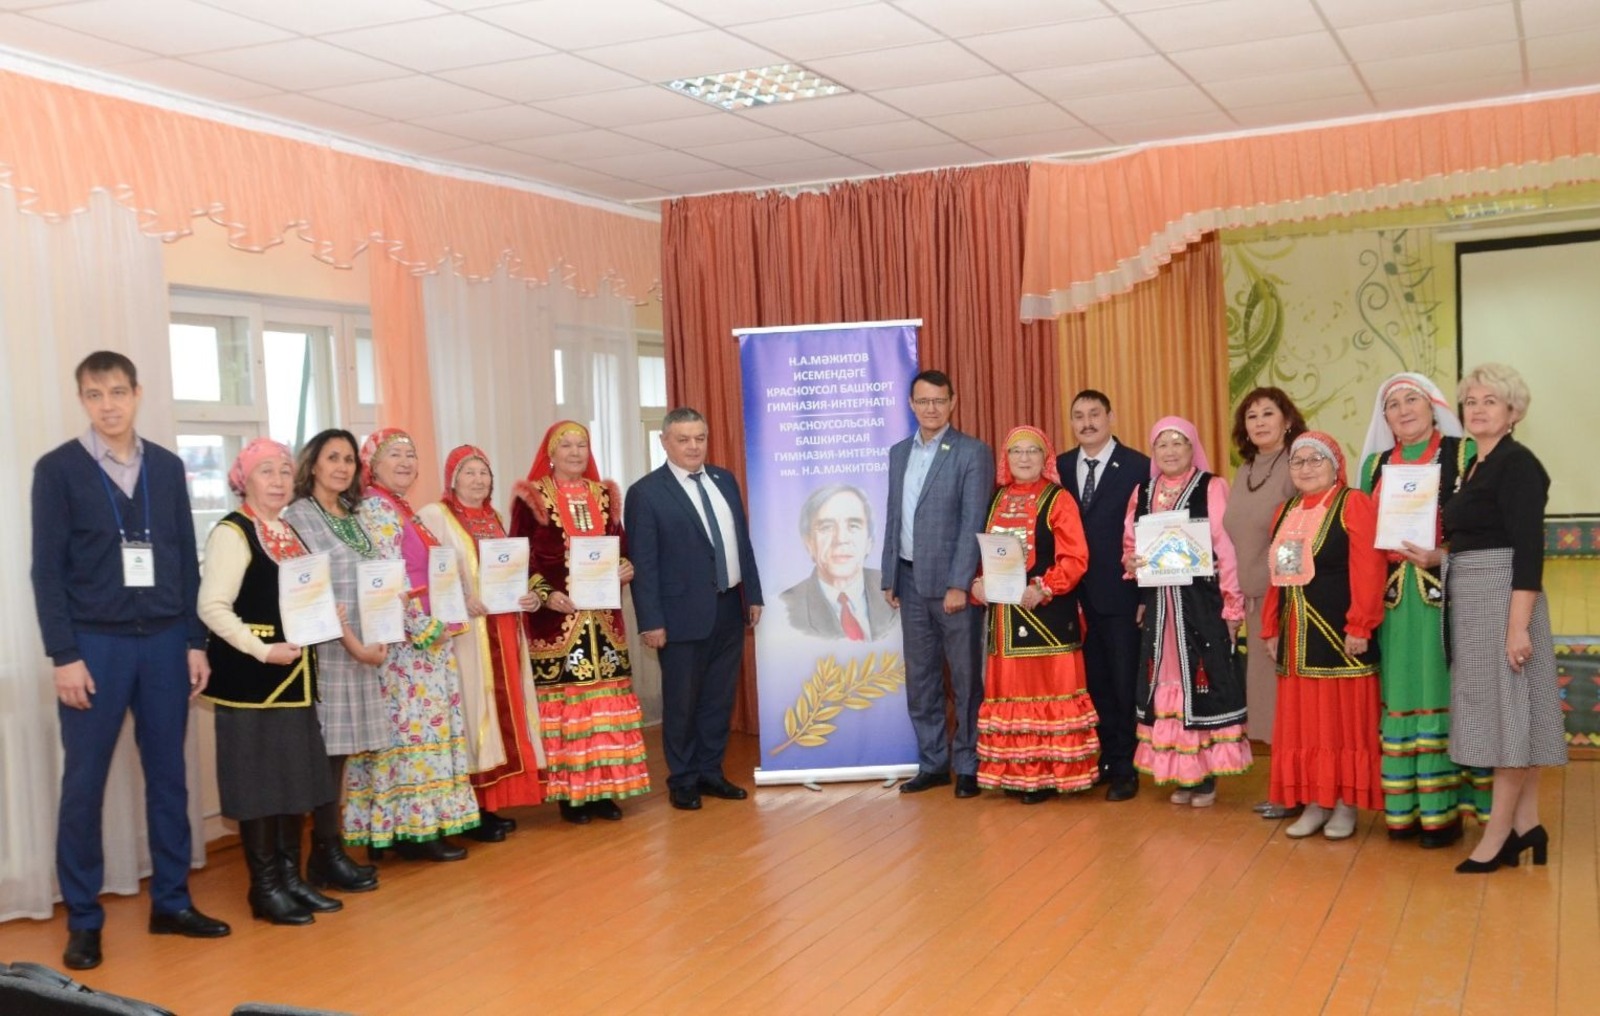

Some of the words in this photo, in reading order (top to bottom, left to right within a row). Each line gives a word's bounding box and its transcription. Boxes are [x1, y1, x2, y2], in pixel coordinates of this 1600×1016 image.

[789, 353, 869, 366] Н.А.МӘЖИТОВ
[794, 368, 867, 381] ИСЕМЕНДӘГЕ
[767, 384, 837, 397] КРАСНОУСОЛ
[767, 397, 895, 412] ГИМНАЗИЯ-ИНТЕРНАТЫ
[779, 418, 885, 432] КРАСНОУСОЛЬСКАЯ
[795, 433, 870, 445] БАШКИРСКАЯ
[802, 462, 888, 475] Н.А.МАЖИТОВА
